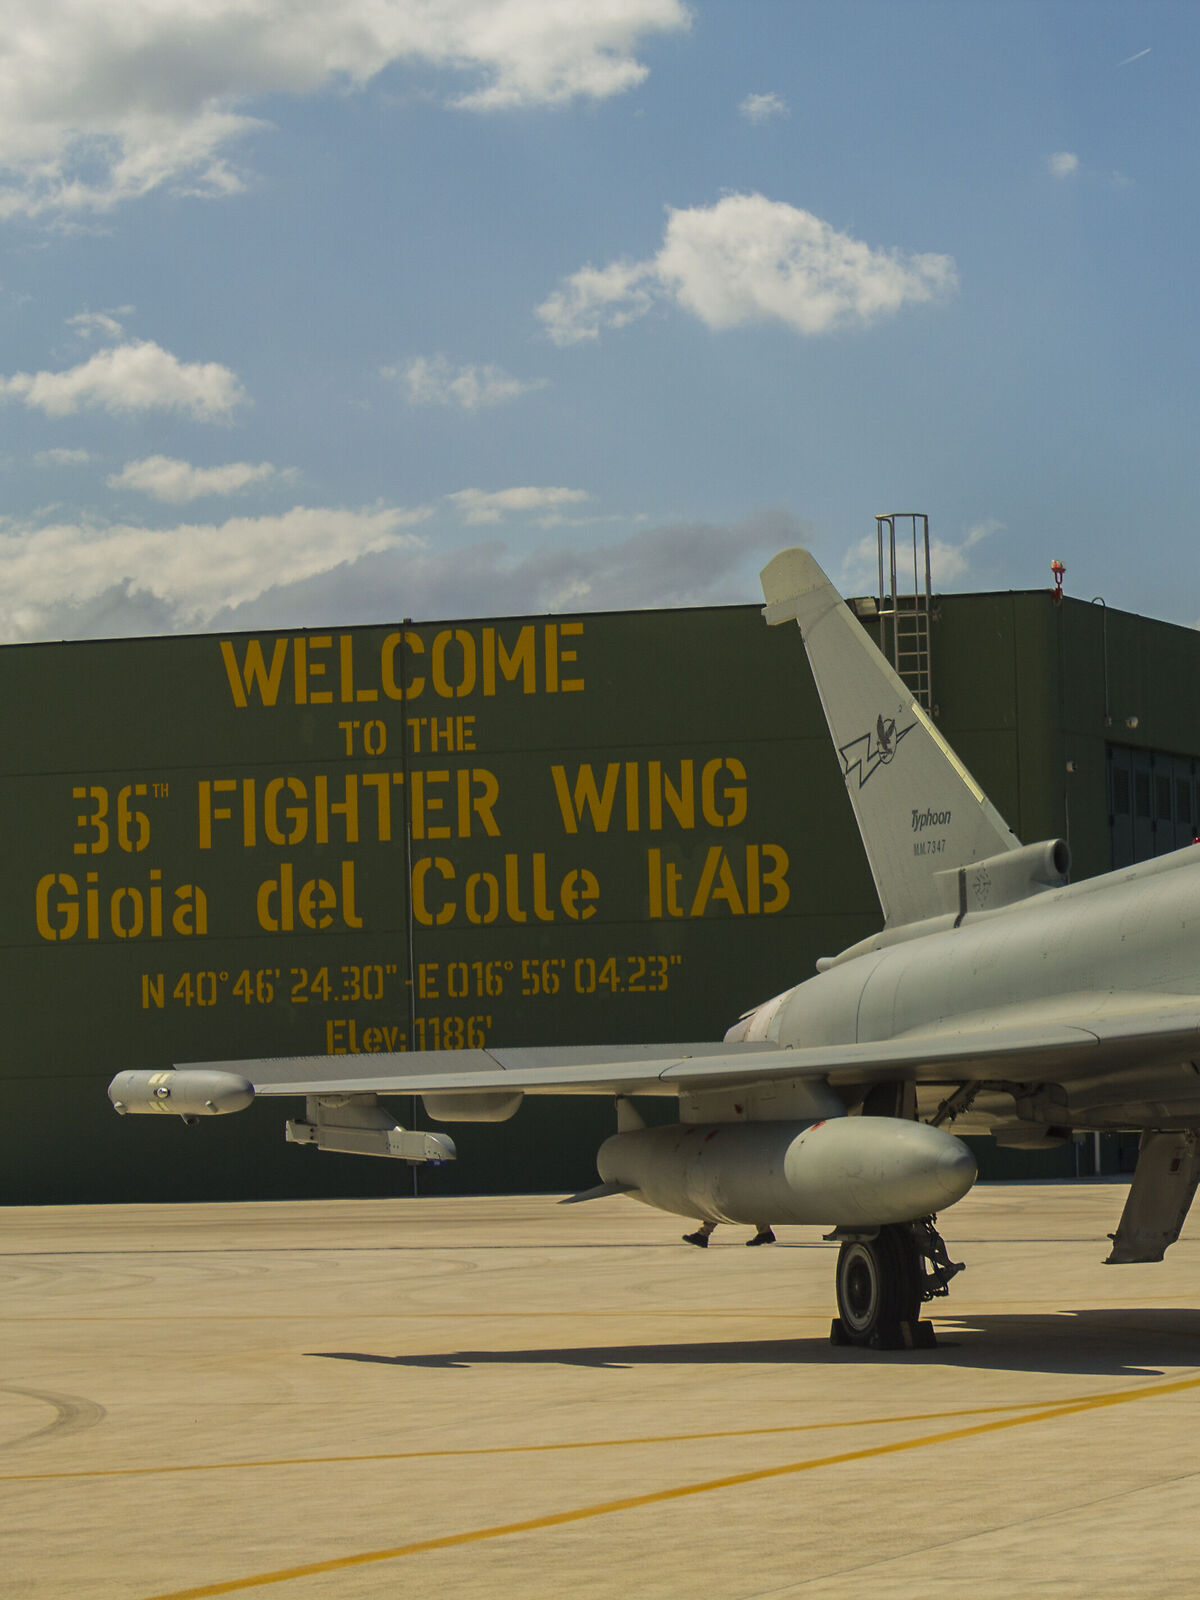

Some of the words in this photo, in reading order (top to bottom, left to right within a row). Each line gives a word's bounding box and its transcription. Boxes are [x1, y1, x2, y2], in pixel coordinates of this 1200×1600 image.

[219, 622, 585, 708] WELCOME
[338, 720, 388, 756] TO
[406, 715, 477, 752] THE
[197, 768, 501, 849] FIGHTER
[550, 757, 749, 834] WING
[911, 808, 951, 832] Typhoon
[35, 869, 209, 941] Gioia
[256, 860, 363, 933] del
[411, 852, 601, 927] Colle
[141, 973, 165, 1009] N
[290, 964, 398, 1003] 24.30"
[418, 963, 440, 999] E
[574, 954, 683, 994] 04.23"
[326, 1019, 407, 1054] Elev:
[413, 1015, 493, 1051] 1186'
